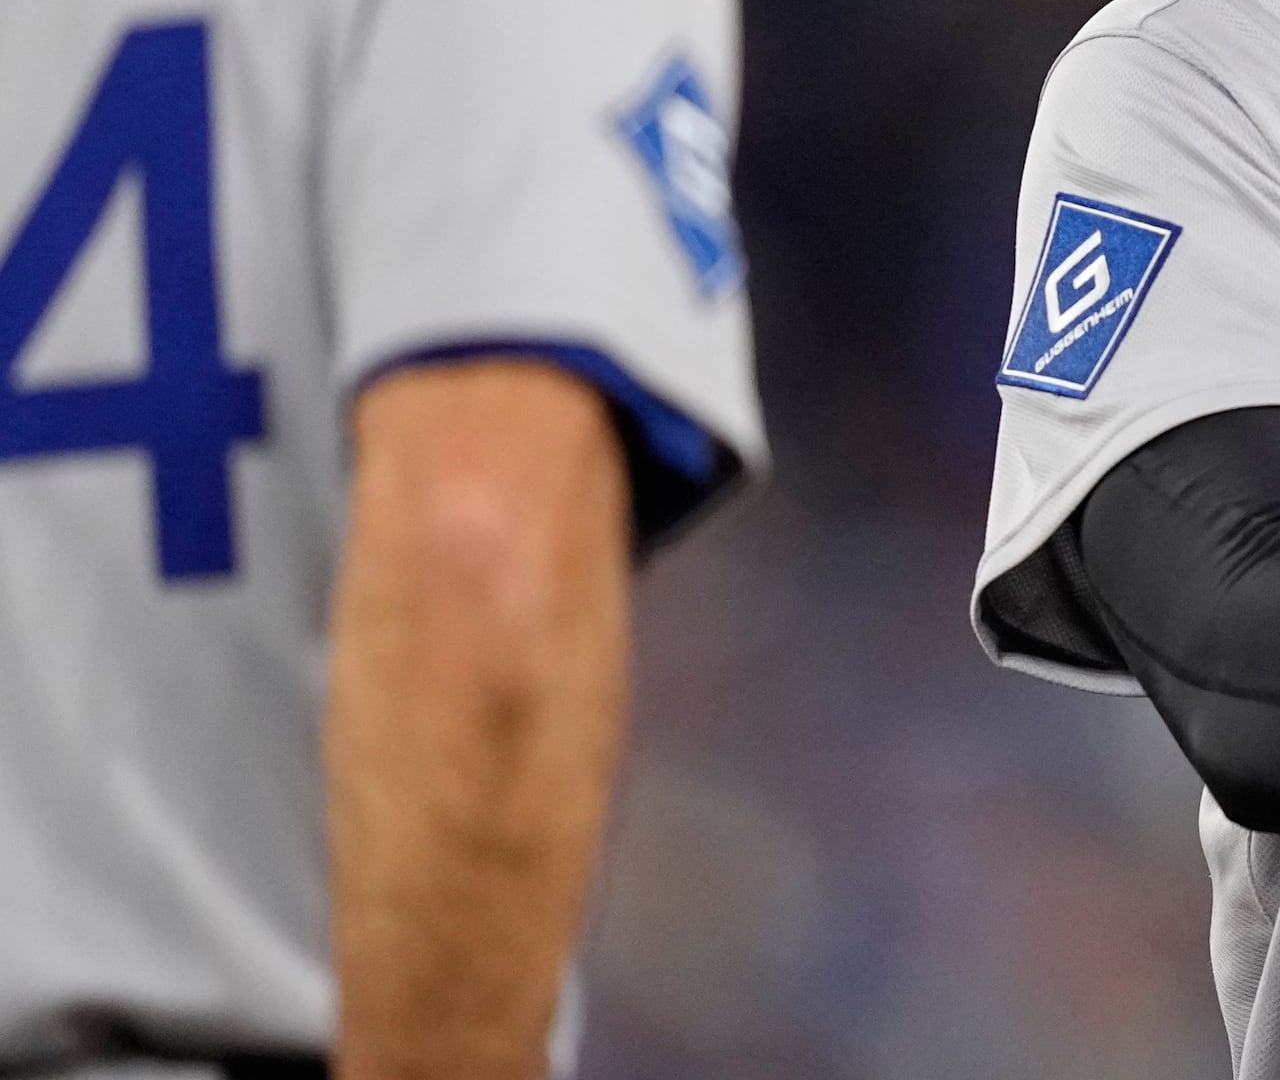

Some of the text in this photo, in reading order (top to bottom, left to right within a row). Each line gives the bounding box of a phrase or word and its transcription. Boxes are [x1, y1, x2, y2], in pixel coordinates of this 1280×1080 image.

[0, 15, 269, 582] 4
[1034, 286, 1134, 374] GUGGENHEIM
[1045, 230, 1112, 334] G
